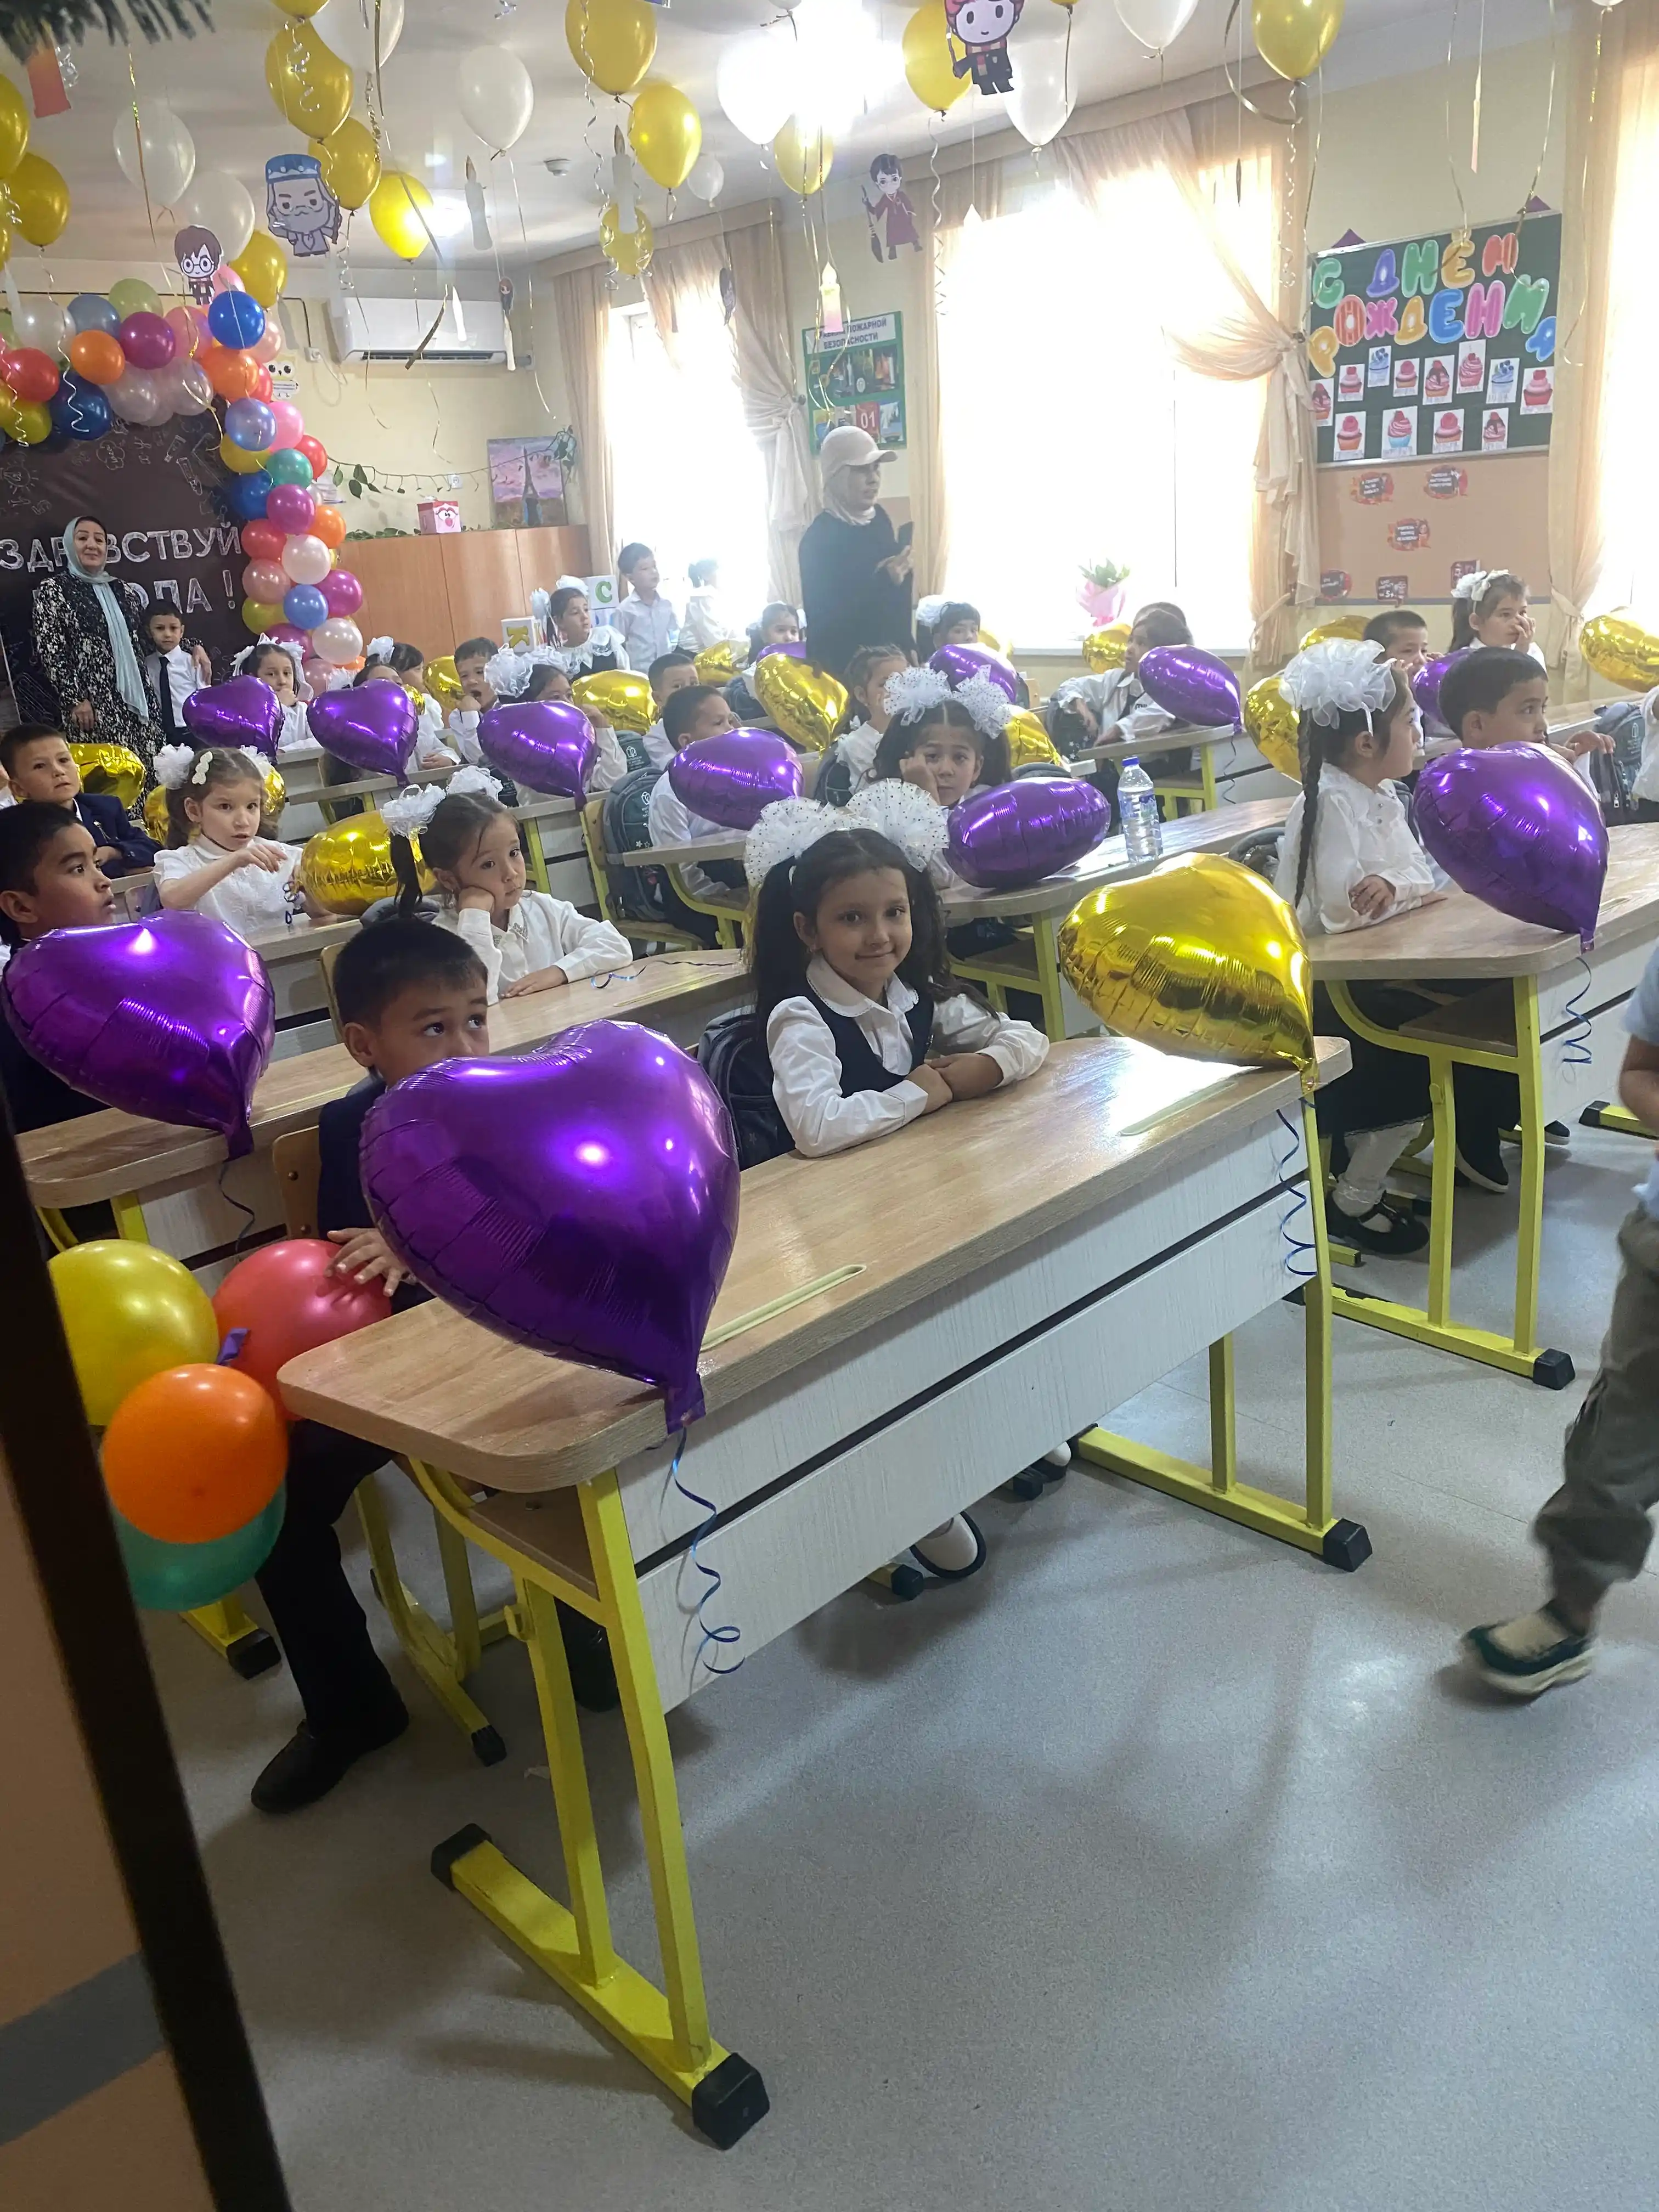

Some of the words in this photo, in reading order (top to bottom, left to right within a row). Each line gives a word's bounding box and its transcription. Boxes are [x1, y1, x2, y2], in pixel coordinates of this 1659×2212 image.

[847, 318, 887, 333] ПОЖАРНОЙ
[824, 332, 878, 349] БЕЗОПАСНОСТИ
[860, 411, 876, 428] 01
[0, 520, 241, 573] ЗДРВСТВУЙ
